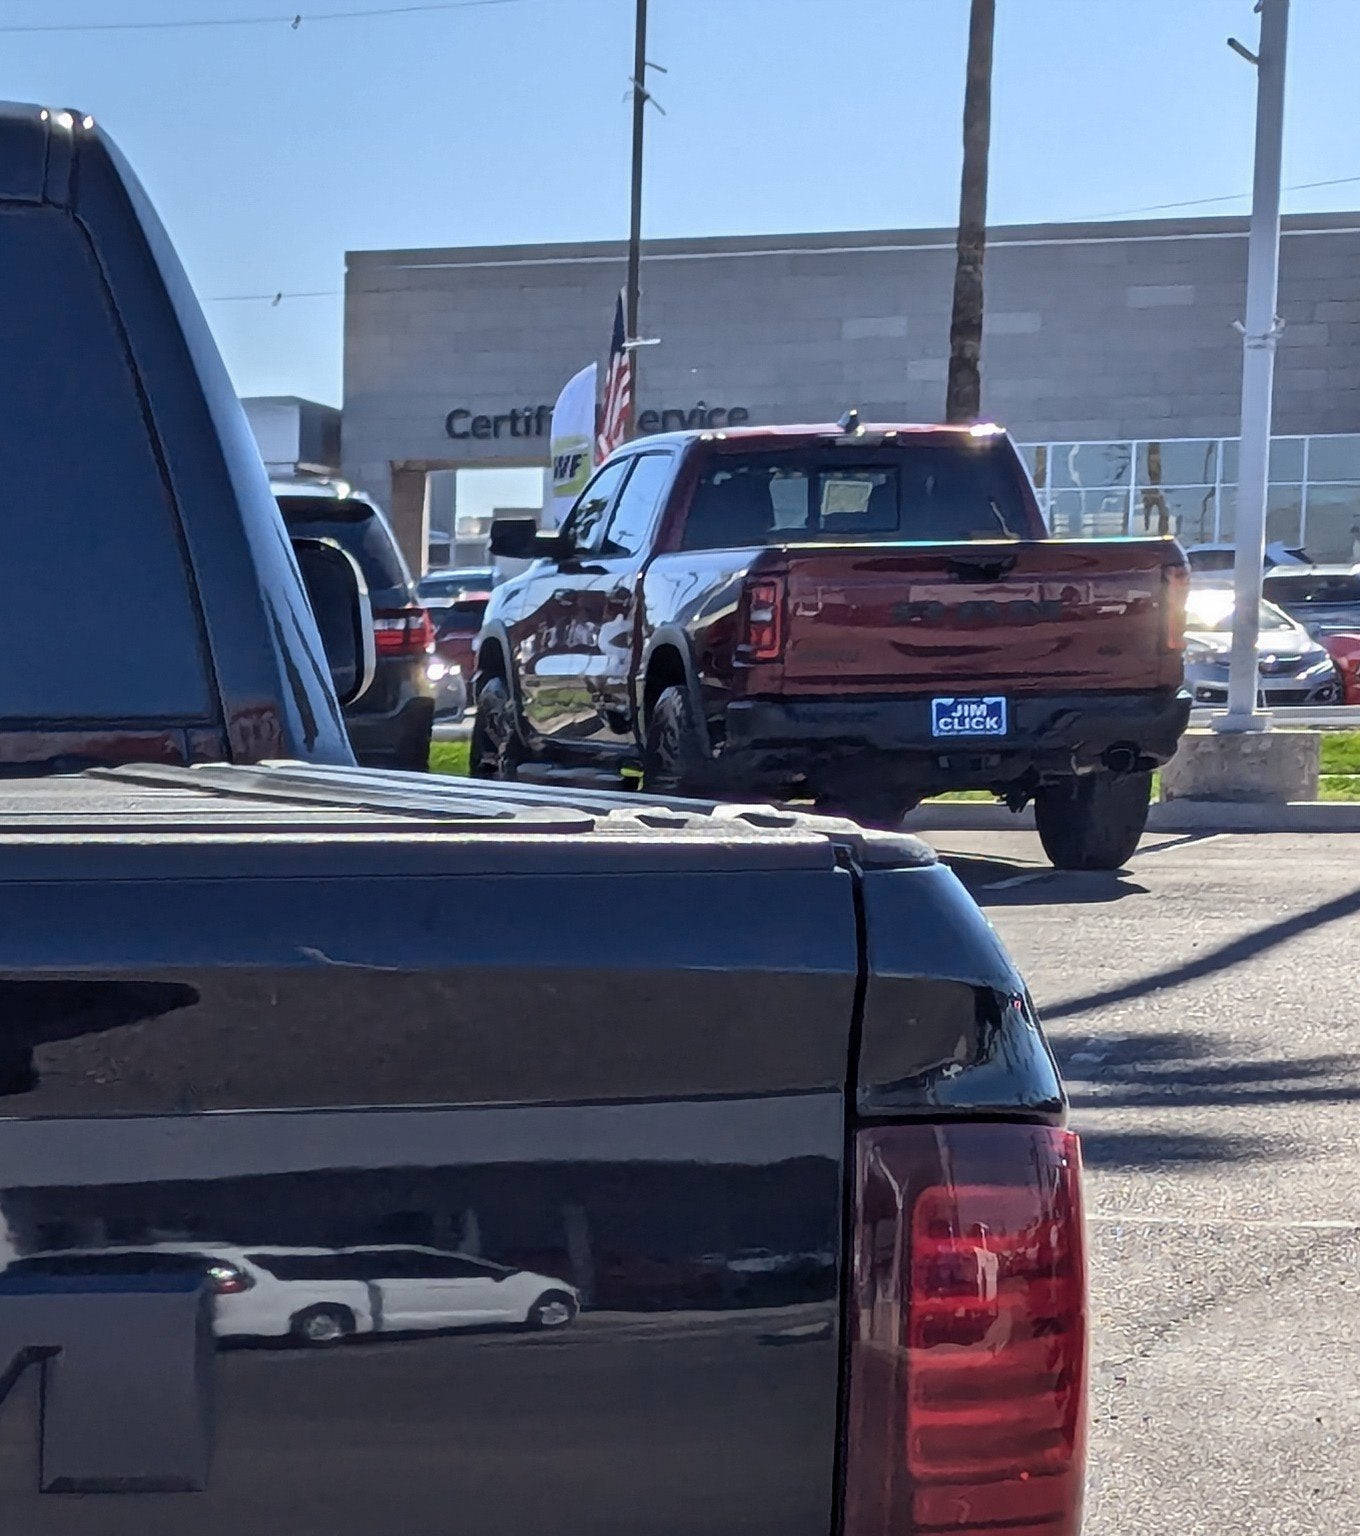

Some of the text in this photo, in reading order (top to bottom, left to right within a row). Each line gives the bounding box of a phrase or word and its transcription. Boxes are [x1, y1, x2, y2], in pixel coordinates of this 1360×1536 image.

[445, 401, 749, 440] Certif ervice
[950, 704, 987, 717] JIM
[938, 717, 999, 731] CLICK
